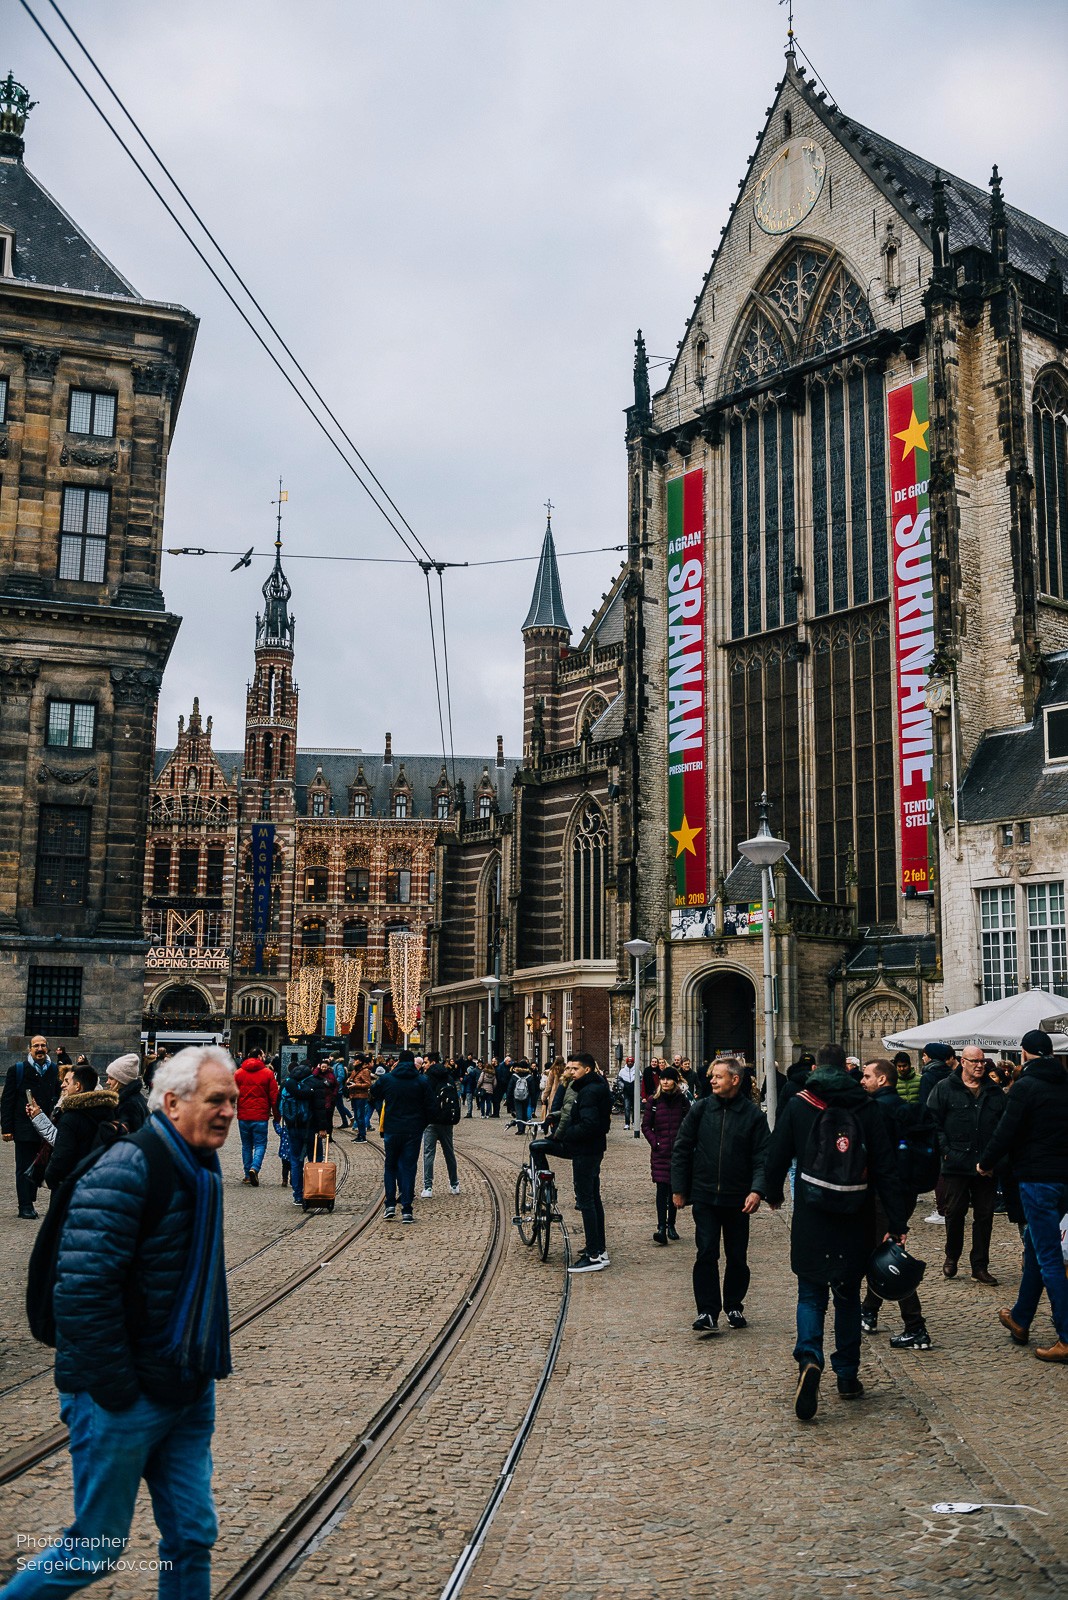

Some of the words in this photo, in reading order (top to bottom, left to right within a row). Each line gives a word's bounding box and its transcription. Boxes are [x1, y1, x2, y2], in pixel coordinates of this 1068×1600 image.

[894, 488, 907, 504] DE
[908, 479, 930, 499] GRO
[675, 530, 701, 552] GRAN
[894, 507, 934, 787] SURINAME
[667, 558, 703, 754] SRANAN
[669, 760, 703, 776] PRESENTERI
[905, 812, 934, 828] STELL
[258, 827, 269, 888] MAGNA
[904, 869, 911, 883] 2
[911, 868, 926, 881] feb
[929, 867, 934, 880] 2
[675, 895, 686, 906] okt
[688, 892, 705, 905] 2019
[257, 894, 265, 946] PLAZA
[145, 947, 184, 958] AGNA
[189, 948, 230, 959] PLAZA
[145, 958, 188, 968] HOPPING
[190, 959, 230, 969] CENTRE
[977, 1038, 1001, 1047] Nieuwe
[1002, 1039, 1018, 1047] Kafé
